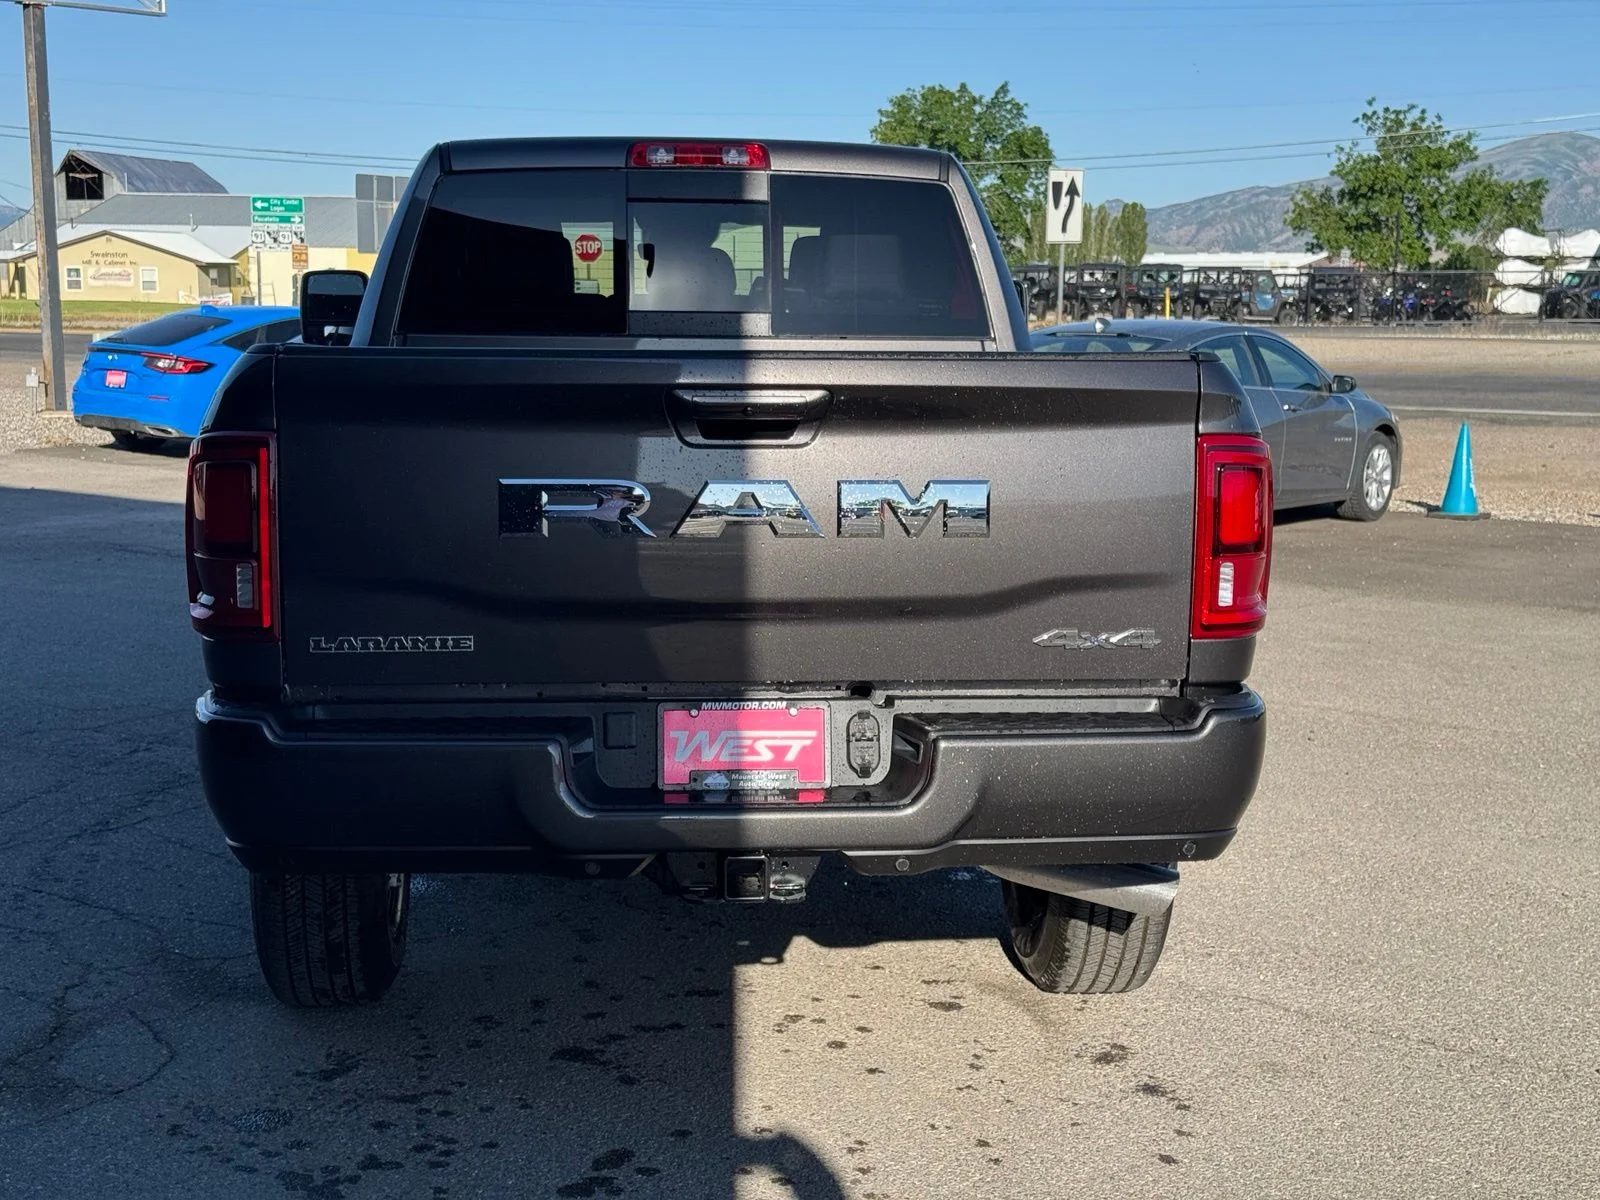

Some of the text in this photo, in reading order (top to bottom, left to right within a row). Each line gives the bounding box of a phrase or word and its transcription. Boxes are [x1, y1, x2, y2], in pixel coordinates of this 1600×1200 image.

[254, 232, 263, 240] 91
[281, 233, 290, 241] 91
[575, 241, 601, 254] STOP
[90, 250, 129, 259] Swainston
[499, 478, 991, 538] RAM
[309, 635, 475, 653] LARAMIE
[1032, 628, 1162, 650] 4x4
[701, 701, 788, 711] MWMOTOR.COM
[669, 730, 818, 762] WEST
[767, 772, 787, 780] West
